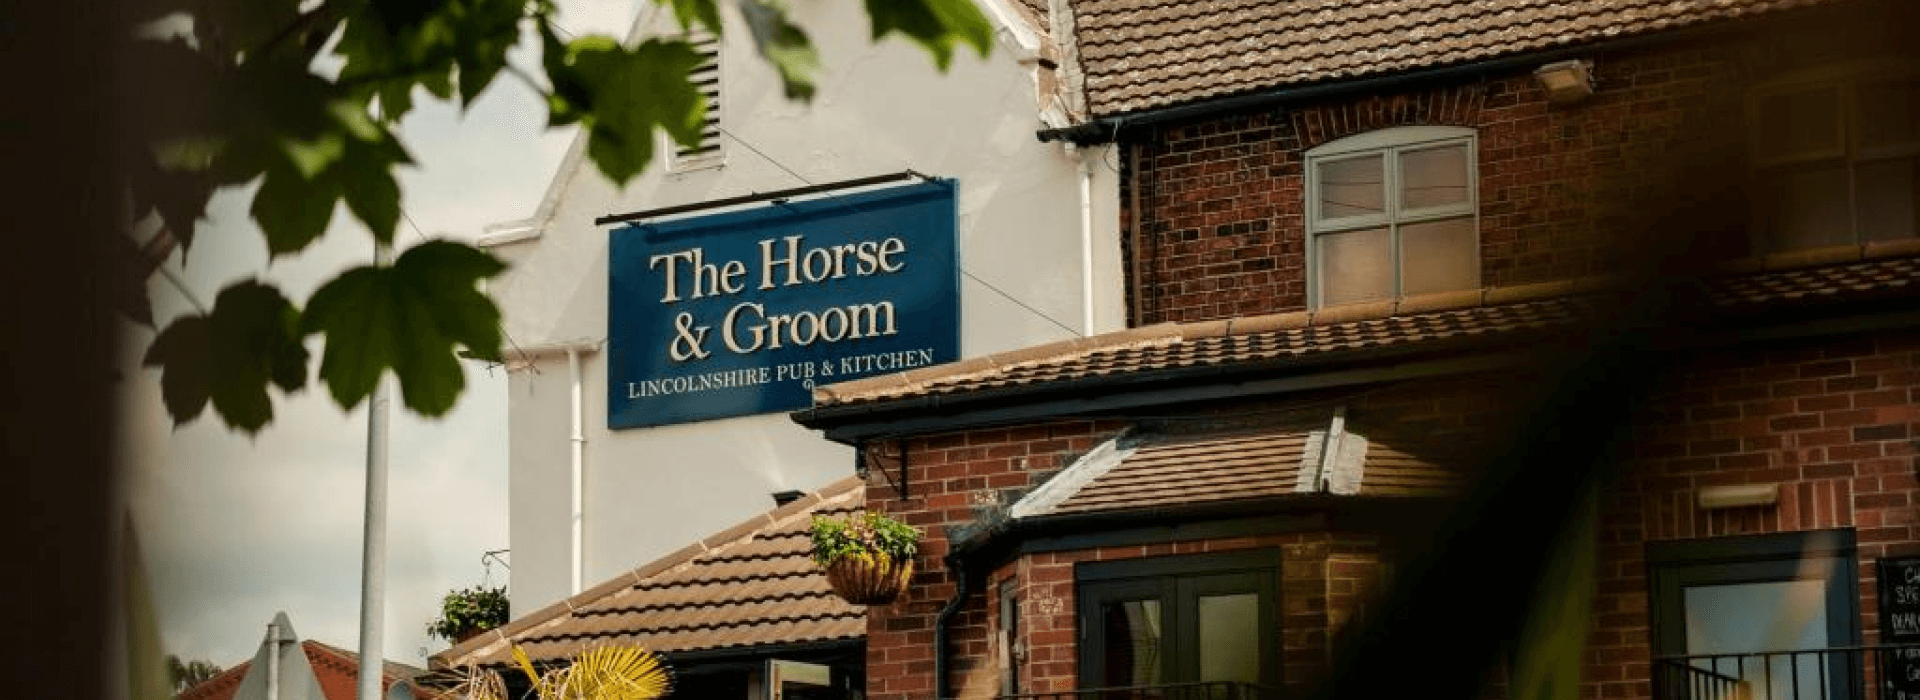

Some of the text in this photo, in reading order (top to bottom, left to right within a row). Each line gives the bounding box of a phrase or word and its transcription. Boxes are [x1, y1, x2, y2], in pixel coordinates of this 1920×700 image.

[650, 235, 905, 303] The Horse
[670, 300, 898, 362] & Groom
[629, 348, 934, 398] LINCOLNSHIRE PUB & KITCHEN
